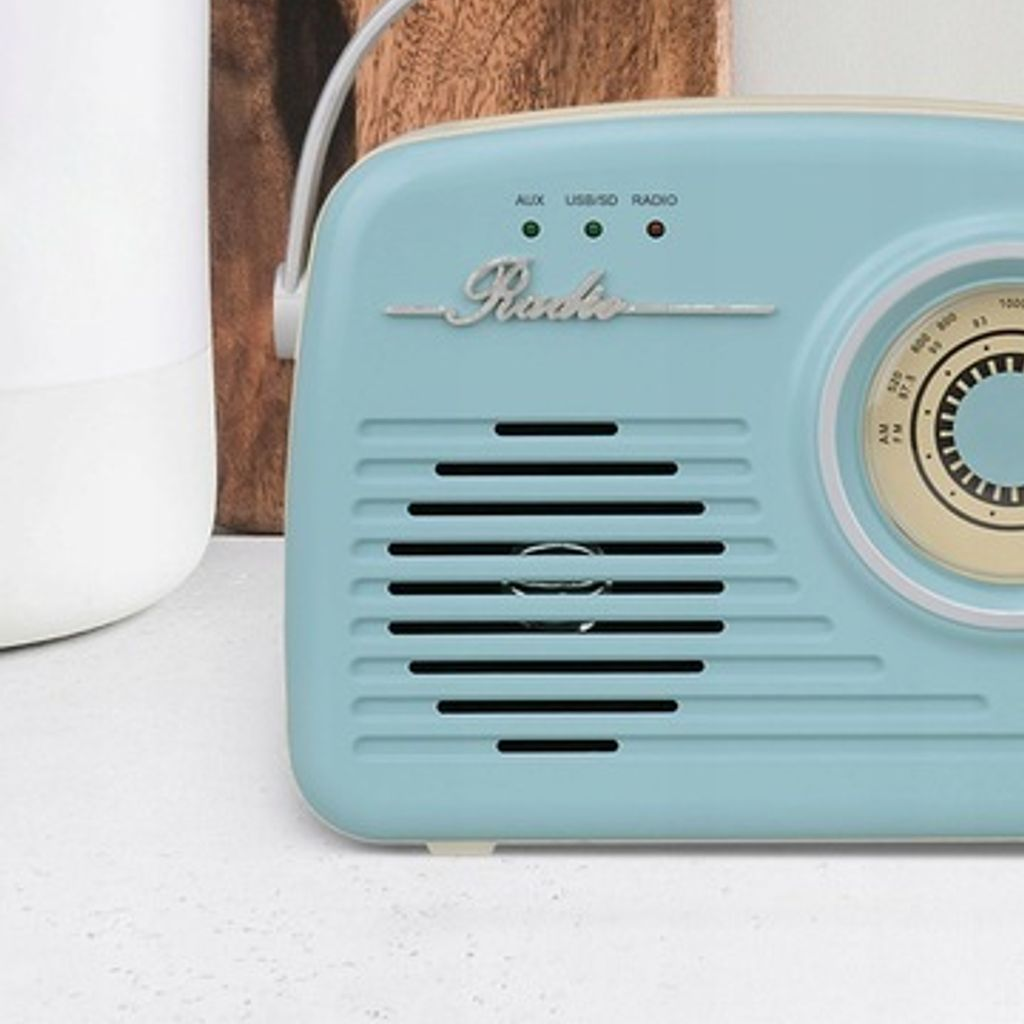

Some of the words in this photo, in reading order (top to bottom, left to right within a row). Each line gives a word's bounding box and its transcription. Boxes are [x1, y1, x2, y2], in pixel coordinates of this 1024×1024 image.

[515, 194, 545, 206] AUX
[631, 194, 679, 206] RADIO
[445, 255, 630, 326] Radio
[879, 424, 889, 445] AM
